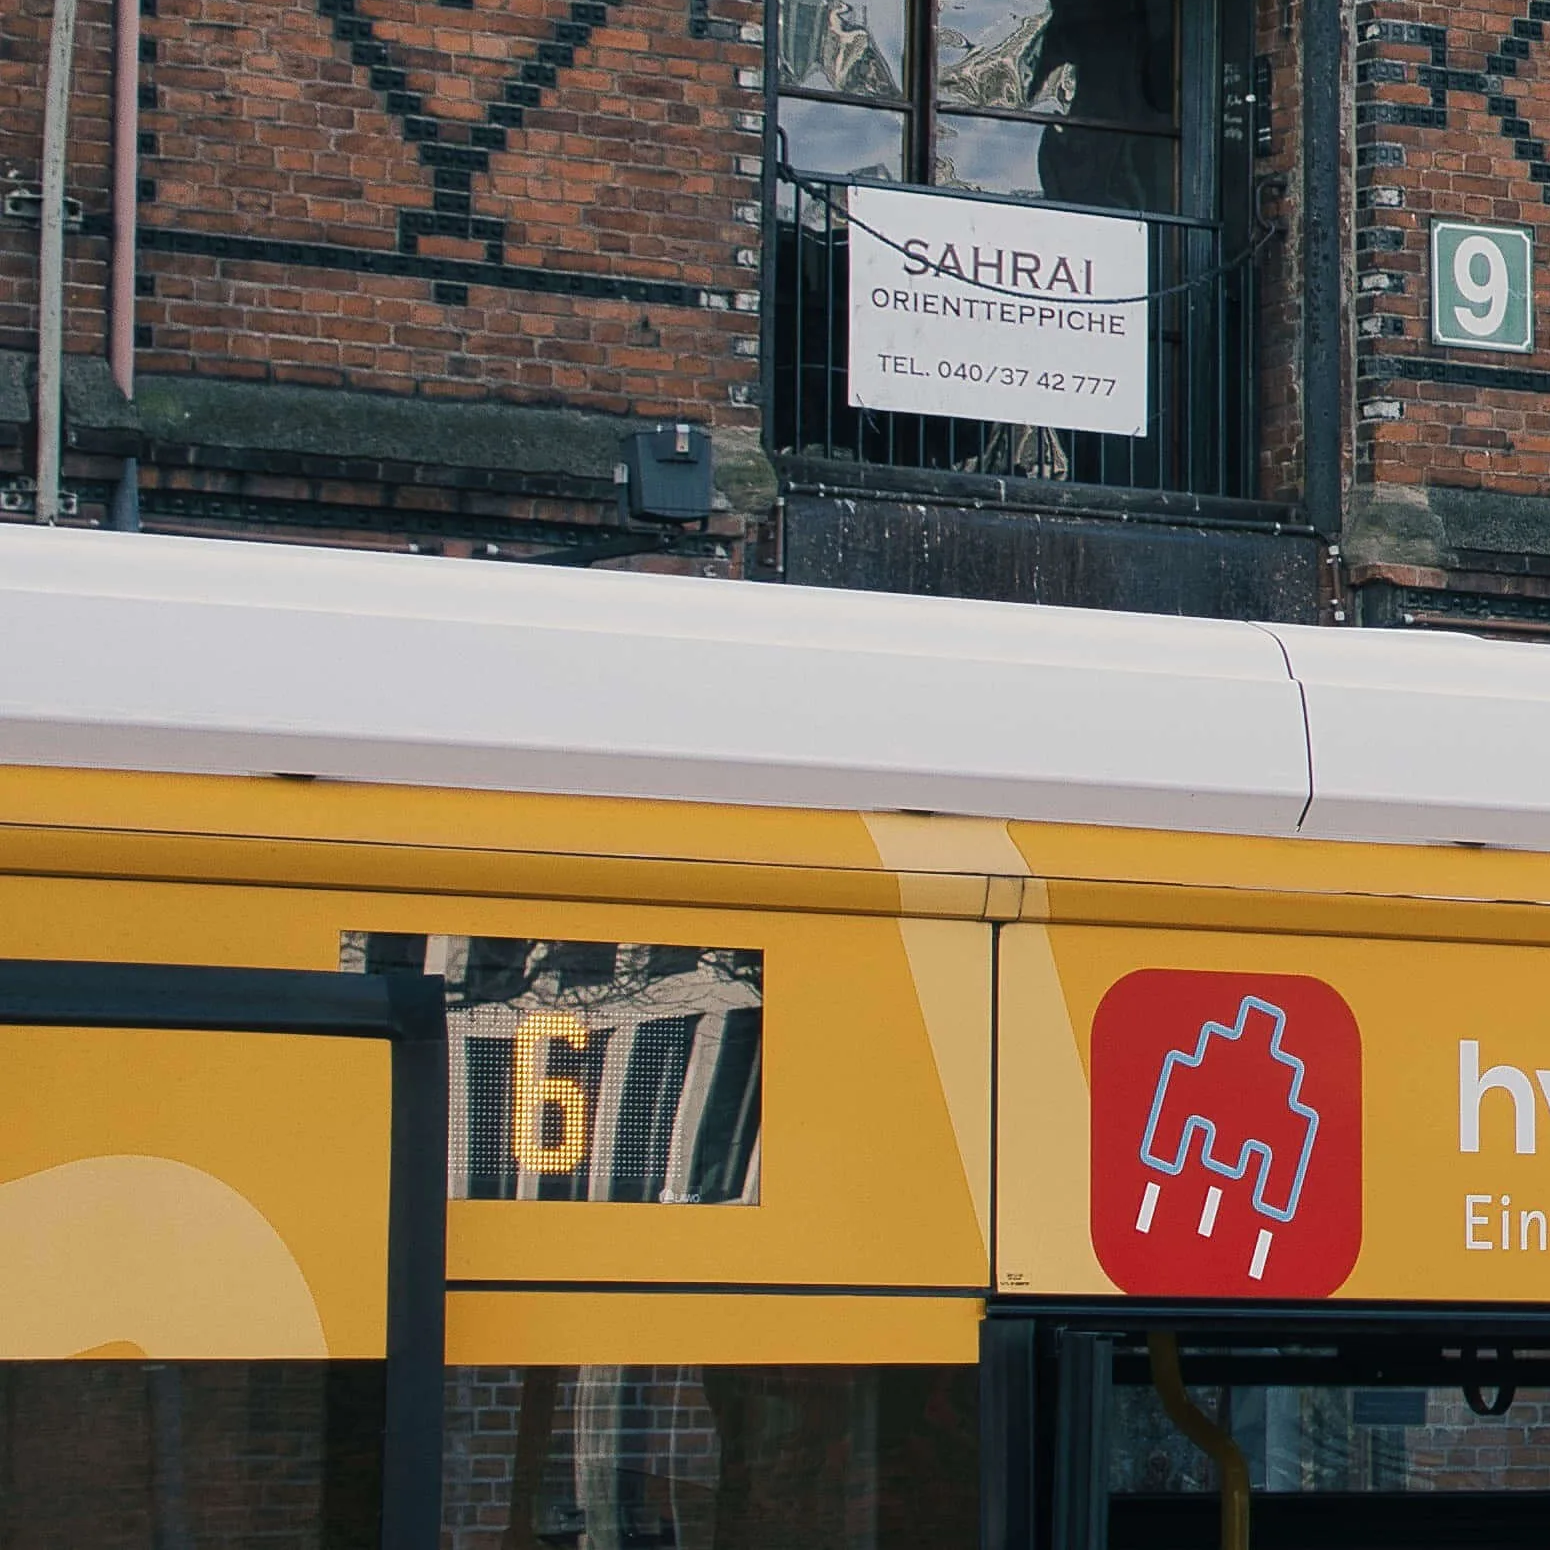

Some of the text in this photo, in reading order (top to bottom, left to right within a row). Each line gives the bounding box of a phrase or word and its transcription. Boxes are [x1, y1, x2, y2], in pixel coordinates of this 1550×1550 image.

[903, 239, 1094, 296] SAHRAI
[1453, 235, 1509, 336] 9
[871, 287, 1126, 336] ORIENTTEPPICHE
[878, 353, 1117, 397] TEL. 040/37 42 777
[513, 1012, 588, 1174] 6
